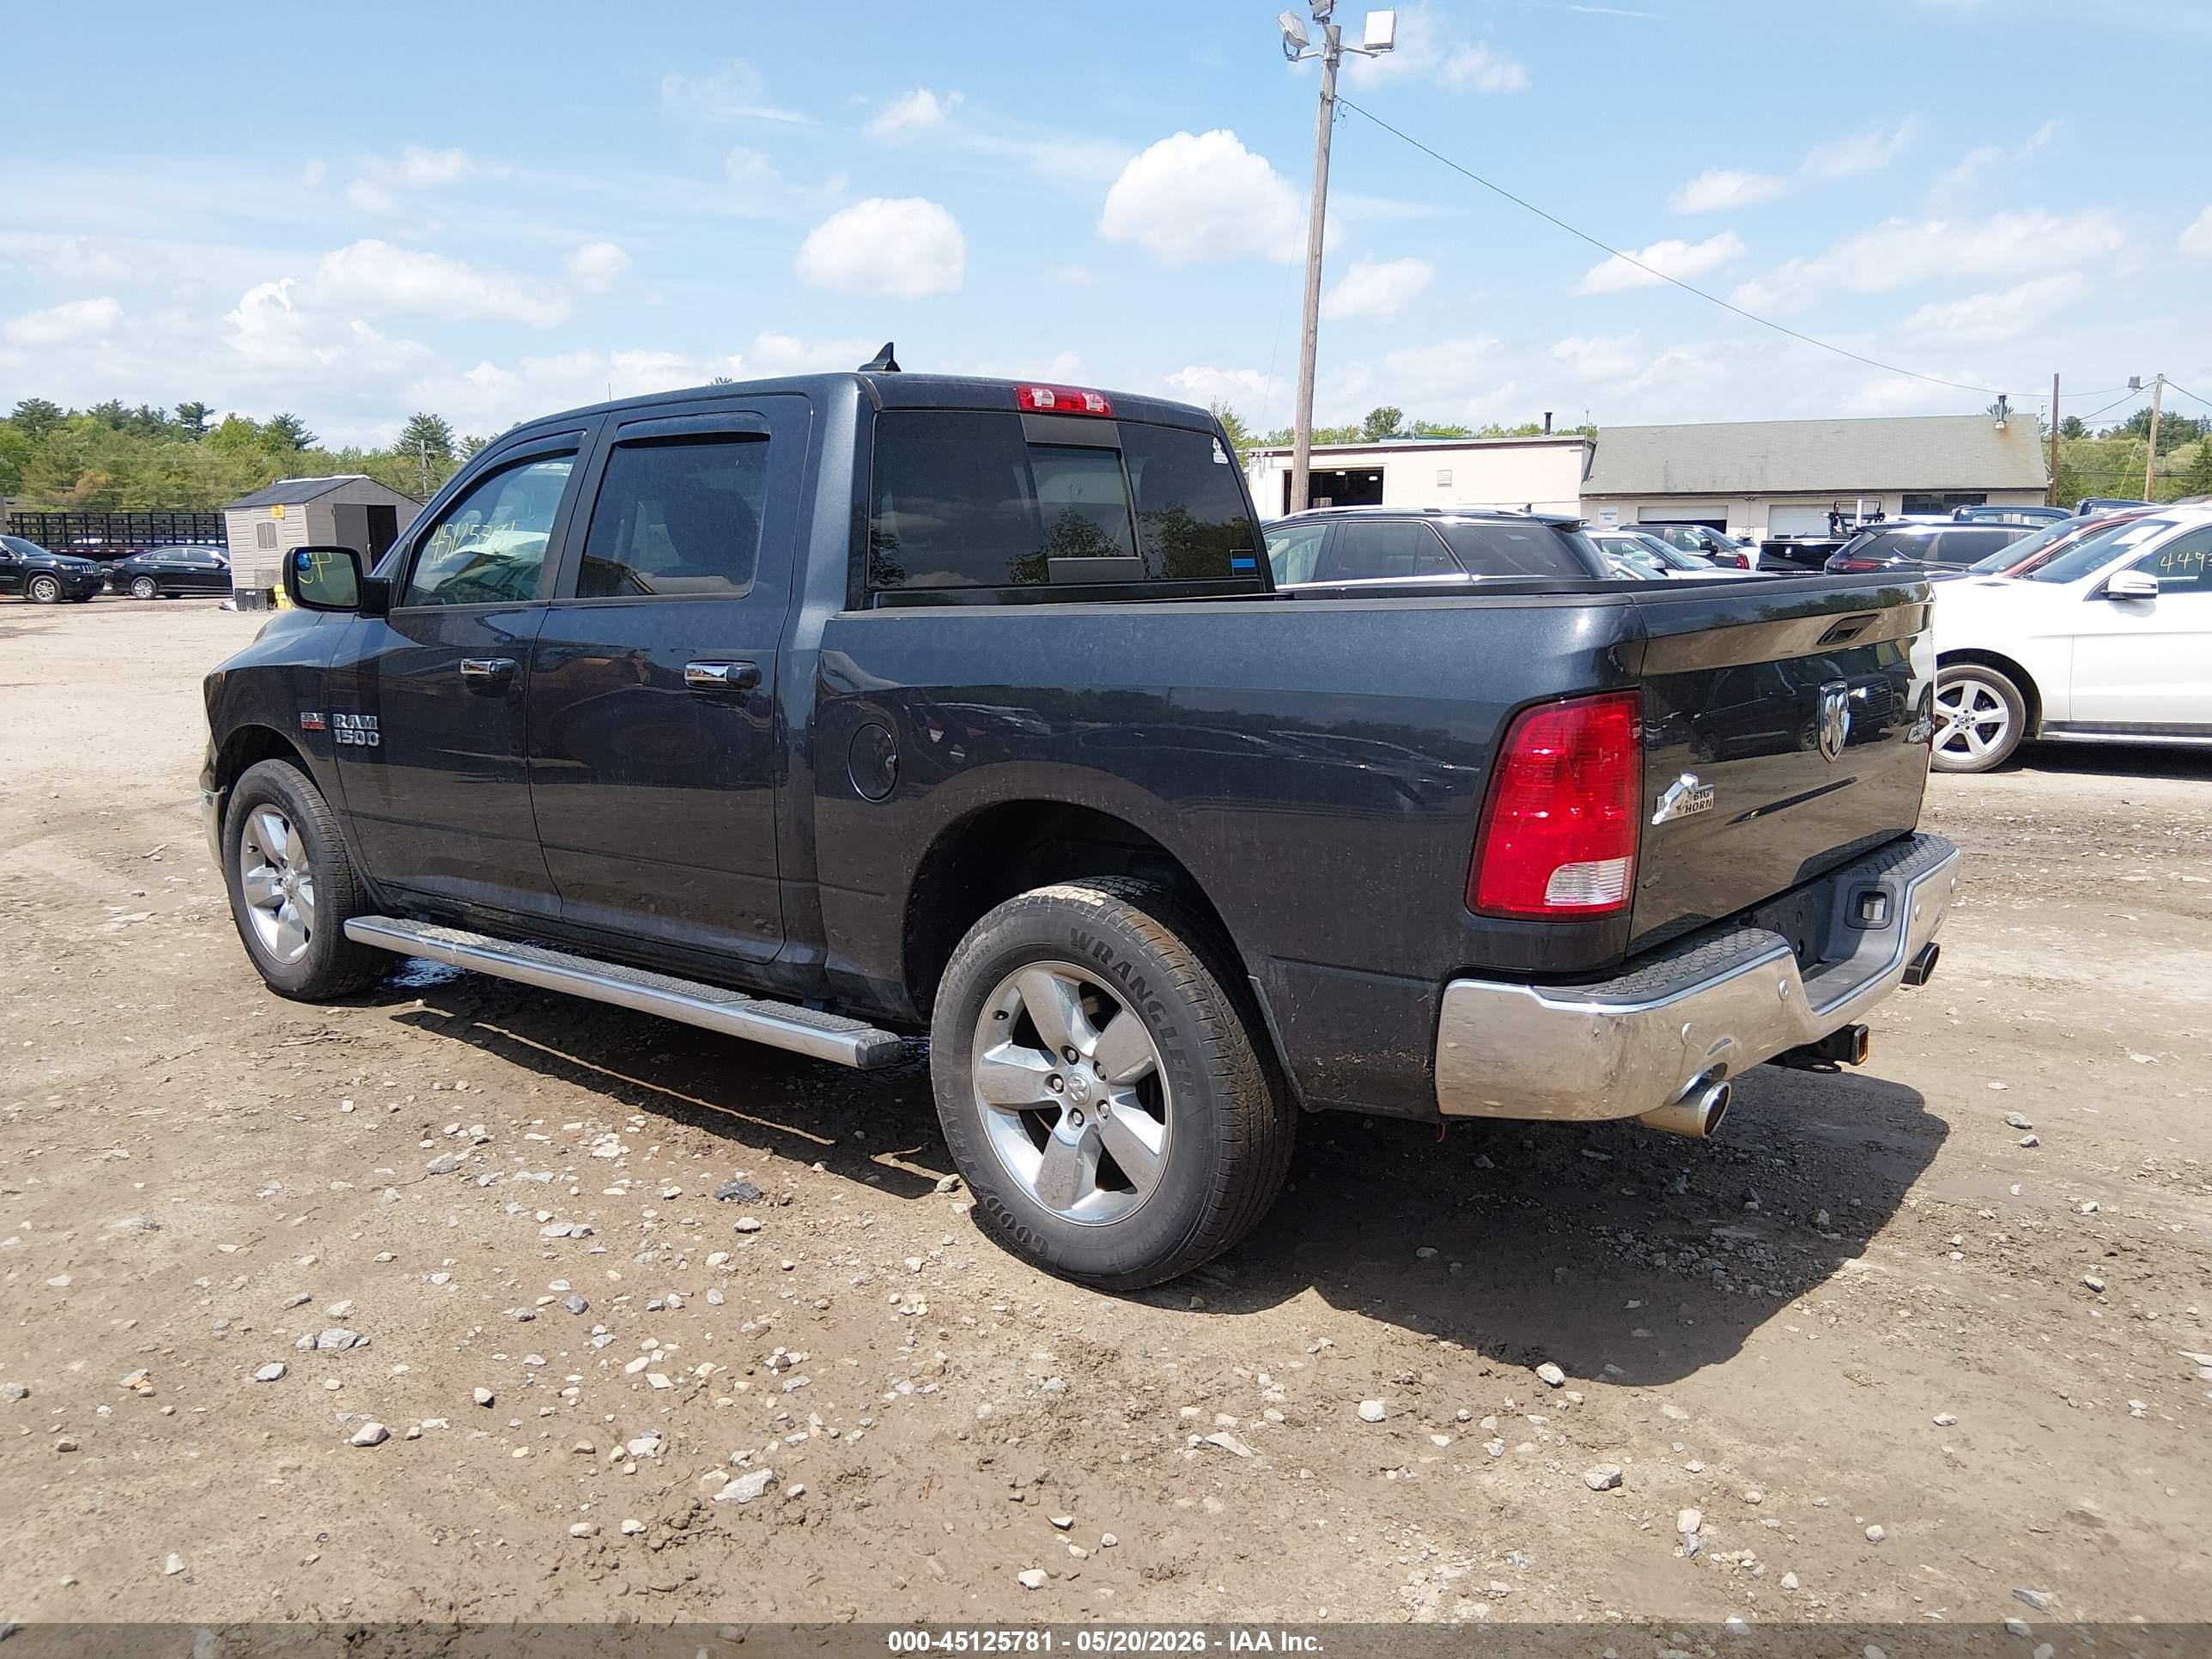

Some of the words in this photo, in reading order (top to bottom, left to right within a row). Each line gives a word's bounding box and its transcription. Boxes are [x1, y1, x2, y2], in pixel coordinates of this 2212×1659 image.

[332, 714, 378, 730] RAM
[334, 729, 380, 746] 1500
[1693, 788, 1711, 801] BIG
[1684, 799, 1712, 814] HORN
[1070, 927, 1196, 1097] WRANGLER
